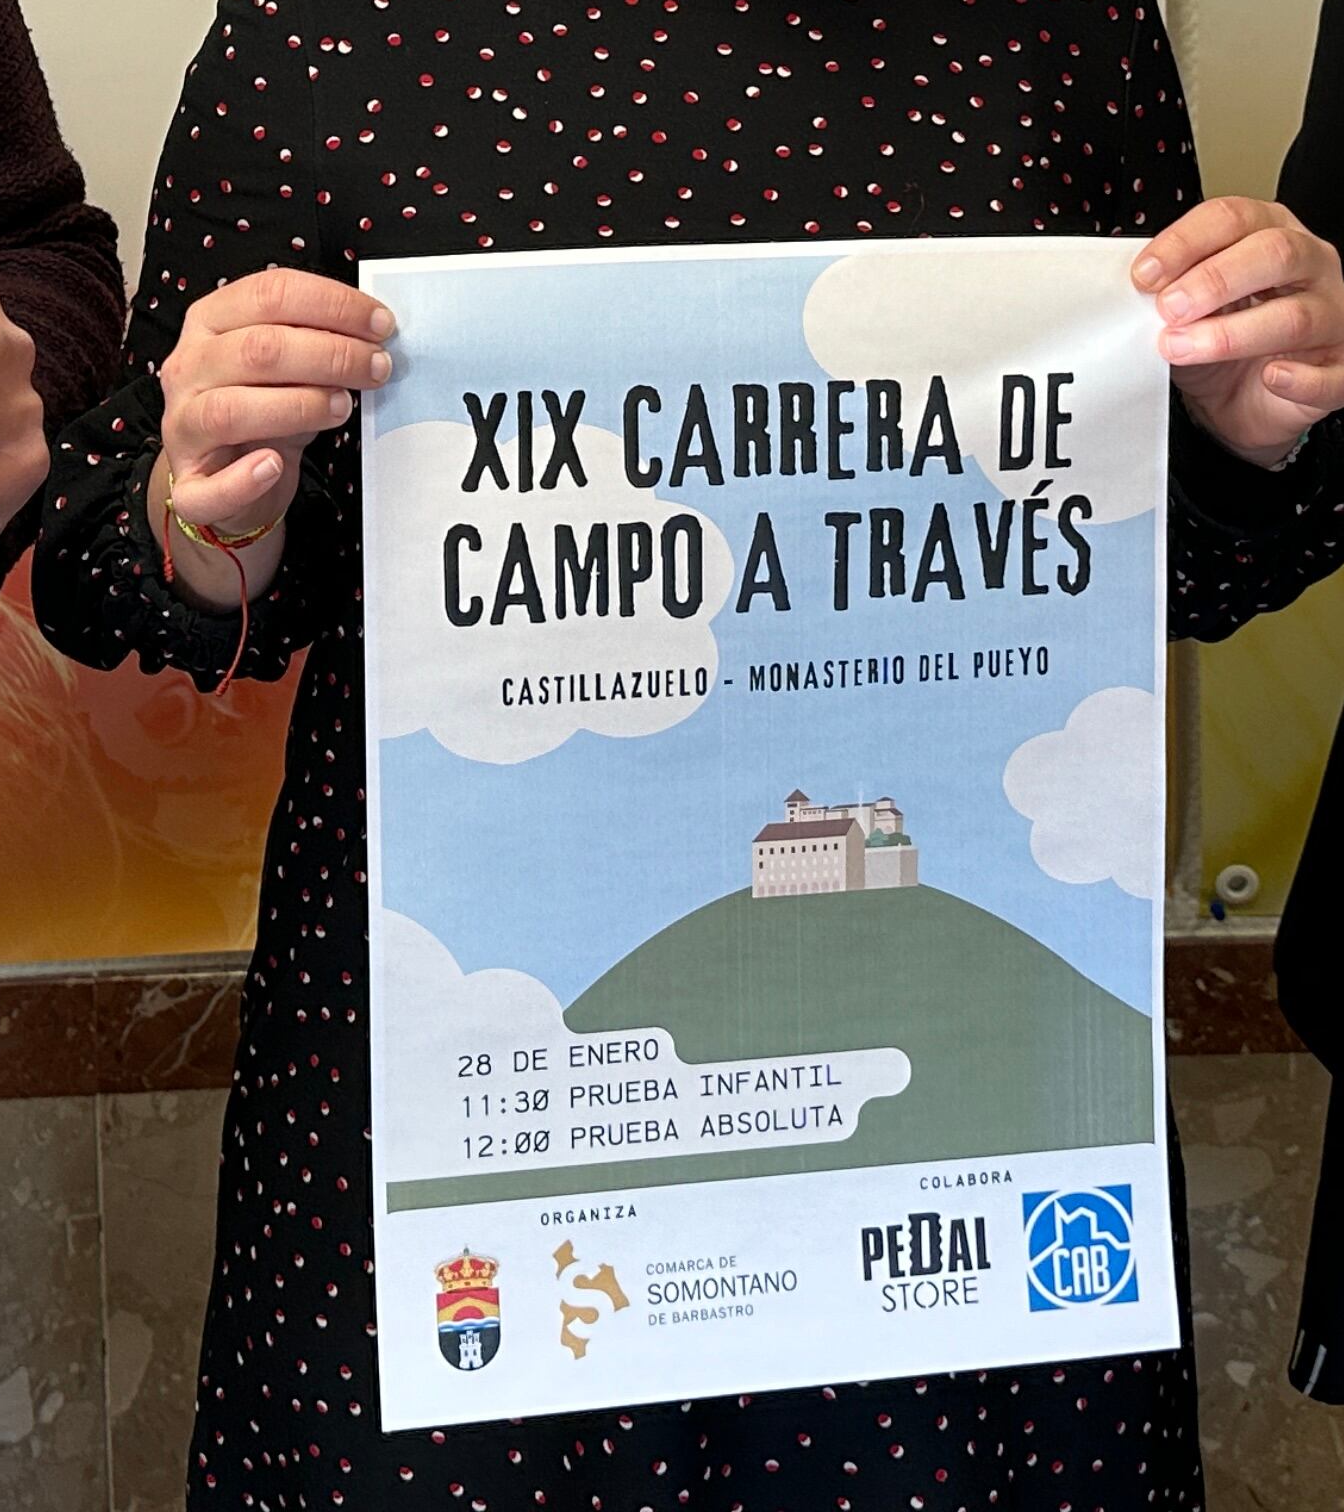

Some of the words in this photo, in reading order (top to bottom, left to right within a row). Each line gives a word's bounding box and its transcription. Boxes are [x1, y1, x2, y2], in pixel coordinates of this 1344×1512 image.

[461, 389, 588, 494] XIX
[622, 375, 964, 489] CARRERA
[998, 372, 1074, 472] DE
[443, 513, 703, 628] CAMPO
[735, 512, 792, 614] A
[824, 478, 1093, 612] TRAVÉS
[502, 667, 707, 706] CASTILLAZUELO
[749, 655, 905, 692] MONASTERIO
[919, 652, 960, 682] DEL
[973, 646, 1048, 679] PUEYO
[458, 1053, 492, 1078] 28
[513, 1048, 548, 1073] DE
[569, 1038, 659, 1068] ENERO
[463, 1089, 550, 1118] 11:30
[570, 1078, 678, 1109] PRUEBA
[700, 1064, 842, 1097] INFANTIL
[464, 1130, 550, 1159] 12:00
[571, 1118, 679, 1149] PRUEBA
[700, 1104, 843, 1138] ABSOLUTA
[919, 1169, 1013, 1190] COLABORA
[540, 1204, 637, 1226] ORGANIZA
[646, 1258, 714, 1276] COMARCA
[719, 1255, 737, 1269] DE
[861, 1212, 991, 1282] PEDAL
[647, 1266, 798, 1305] SOMONTANO
[1053, 1245, 1111, 1297] CAB
[648, 1312, 666, 1326] DE
[672, 1304, 754, 1324] BARBASTRO
[882, 1276, 978, 1313] STORE
